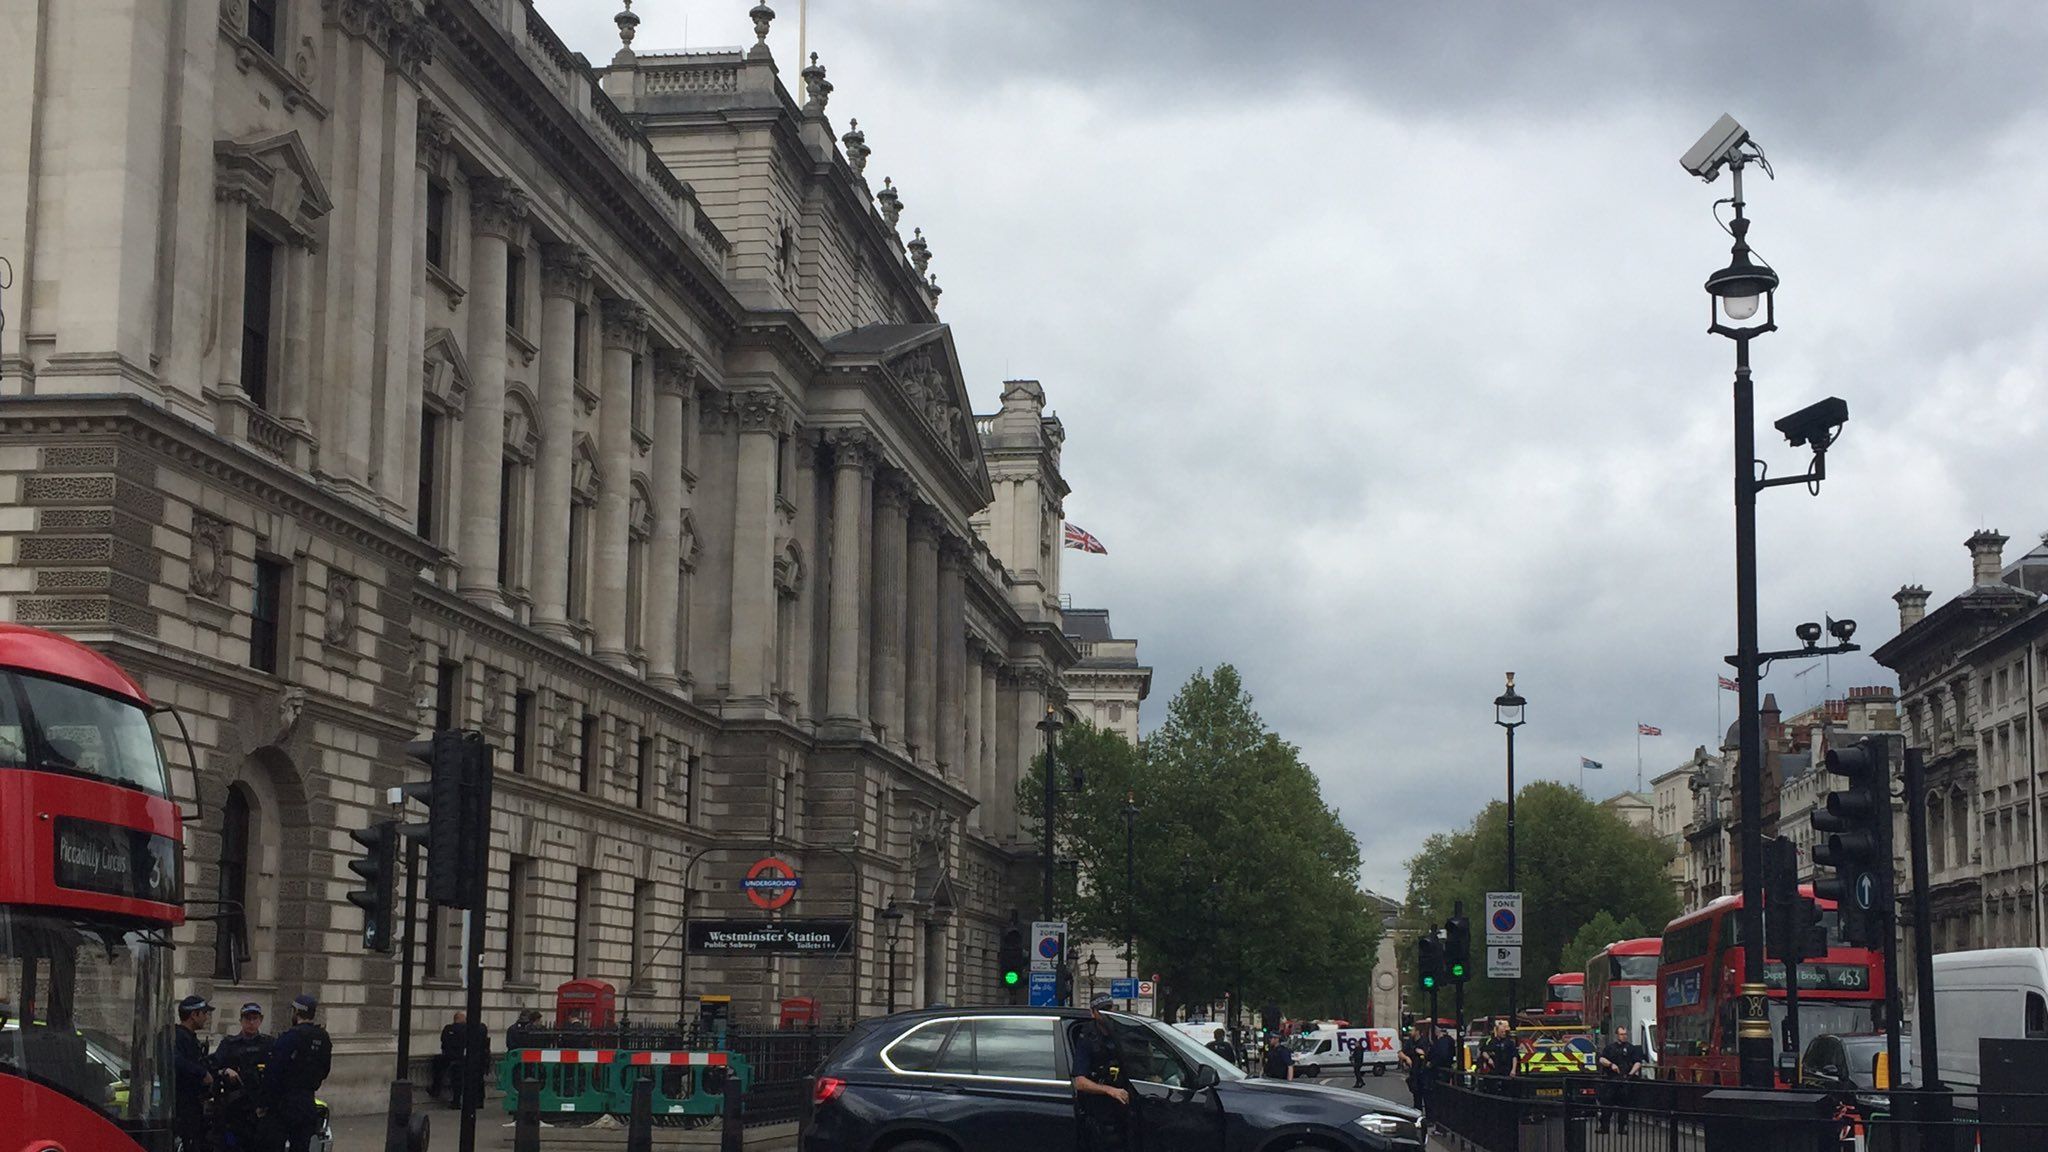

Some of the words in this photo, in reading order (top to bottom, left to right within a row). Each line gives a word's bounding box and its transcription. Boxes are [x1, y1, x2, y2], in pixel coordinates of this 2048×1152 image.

[60, 836, 100, 874] Piccadilly
[101, 846, 126, 873] Circus
[709, 931, 784, 942] Westminster
[787, 931, 831, 942] Station
[729, 942, 757, 950] Subway
[1801, 970, 1826, 983] Bridge
[1838, 970, 1861, 986] 453
[1336, 1030, 1393, 1053] FedEx
